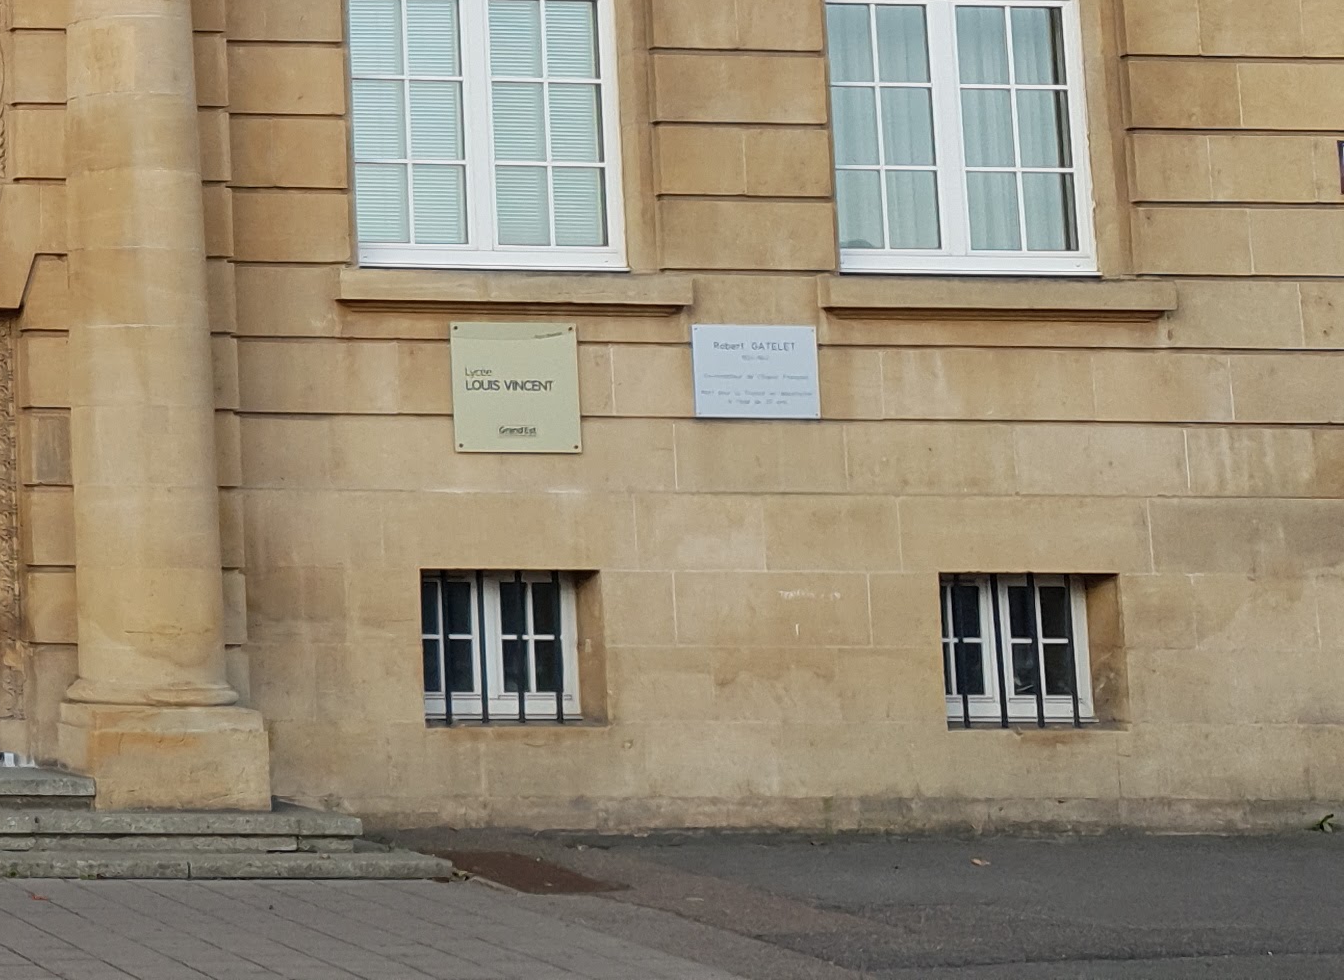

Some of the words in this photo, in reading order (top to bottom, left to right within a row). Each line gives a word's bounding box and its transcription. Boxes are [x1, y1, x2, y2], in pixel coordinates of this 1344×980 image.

[713, 341, 744, 351] Robert
[465, 380, 501, 391] LOUIS
[504, 380, 553, 392] VINCENT
